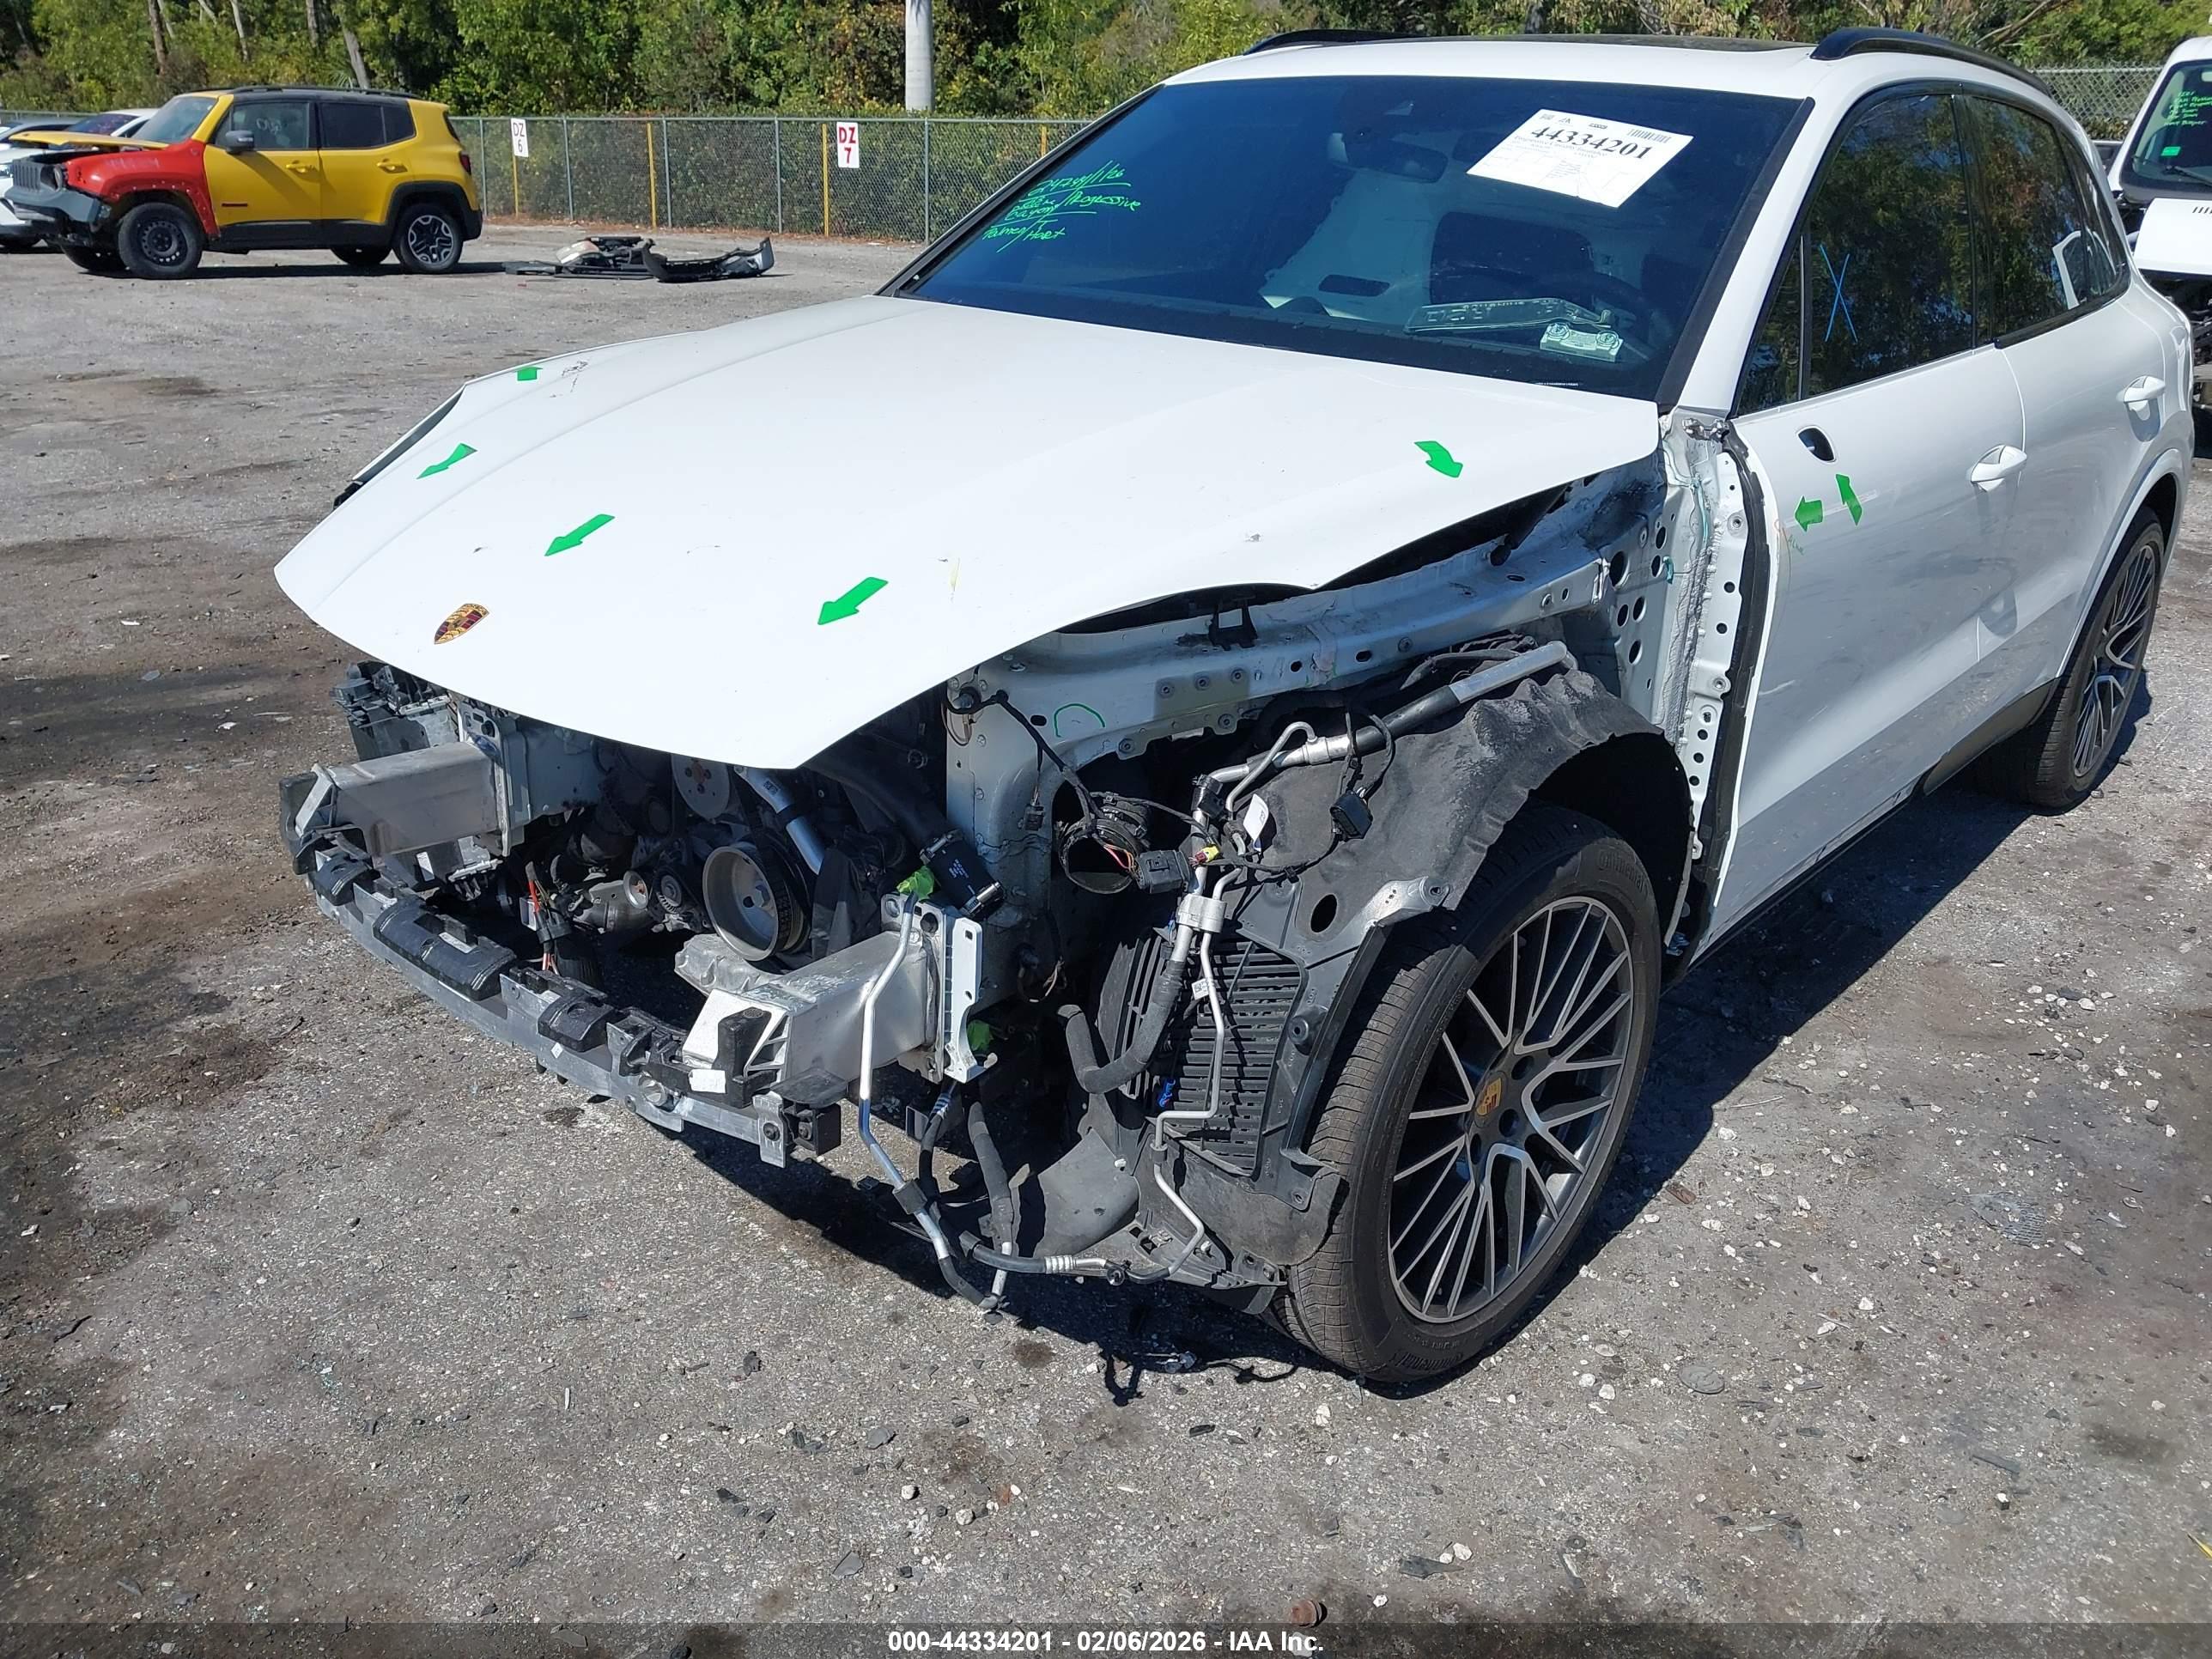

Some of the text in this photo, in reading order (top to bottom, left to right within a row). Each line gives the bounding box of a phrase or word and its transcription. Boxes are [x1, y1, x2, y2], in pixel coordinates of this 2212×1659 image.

[513, 122, 525, 137] DZ
[839, 126, 856, 143] DZ
[518, 138, 524, 153] 6
[1531, 126, 1653, 160] 44334201
[844, 147, 852, 164] 7
